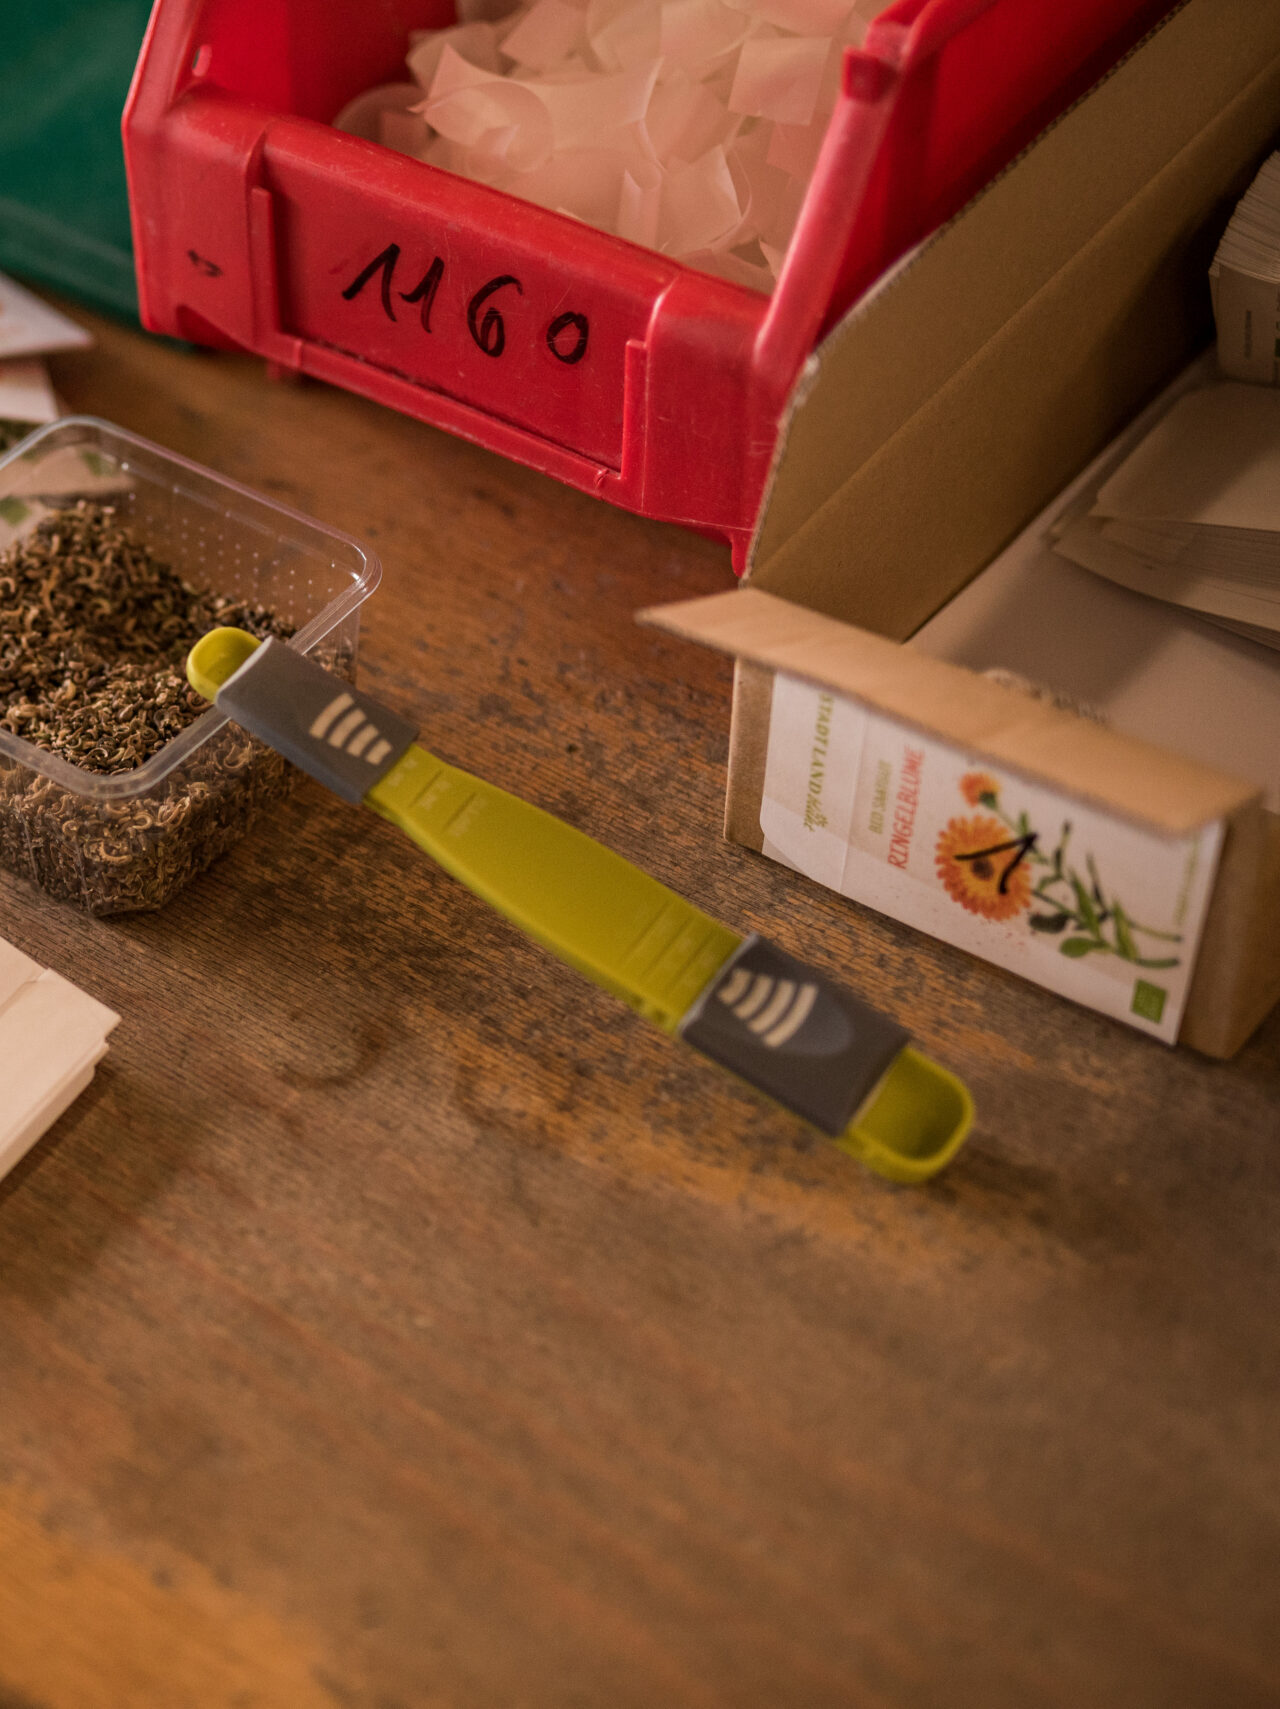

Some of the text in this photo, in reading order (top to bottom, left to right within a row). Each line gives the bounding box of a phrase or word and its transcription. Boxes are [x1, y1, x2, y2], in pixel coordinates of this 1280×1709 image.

[341, 242, 590, 365] 1160
[808, 746, 826, 795] LAND
[886, 744, 922, 871] RINGELBLUME
